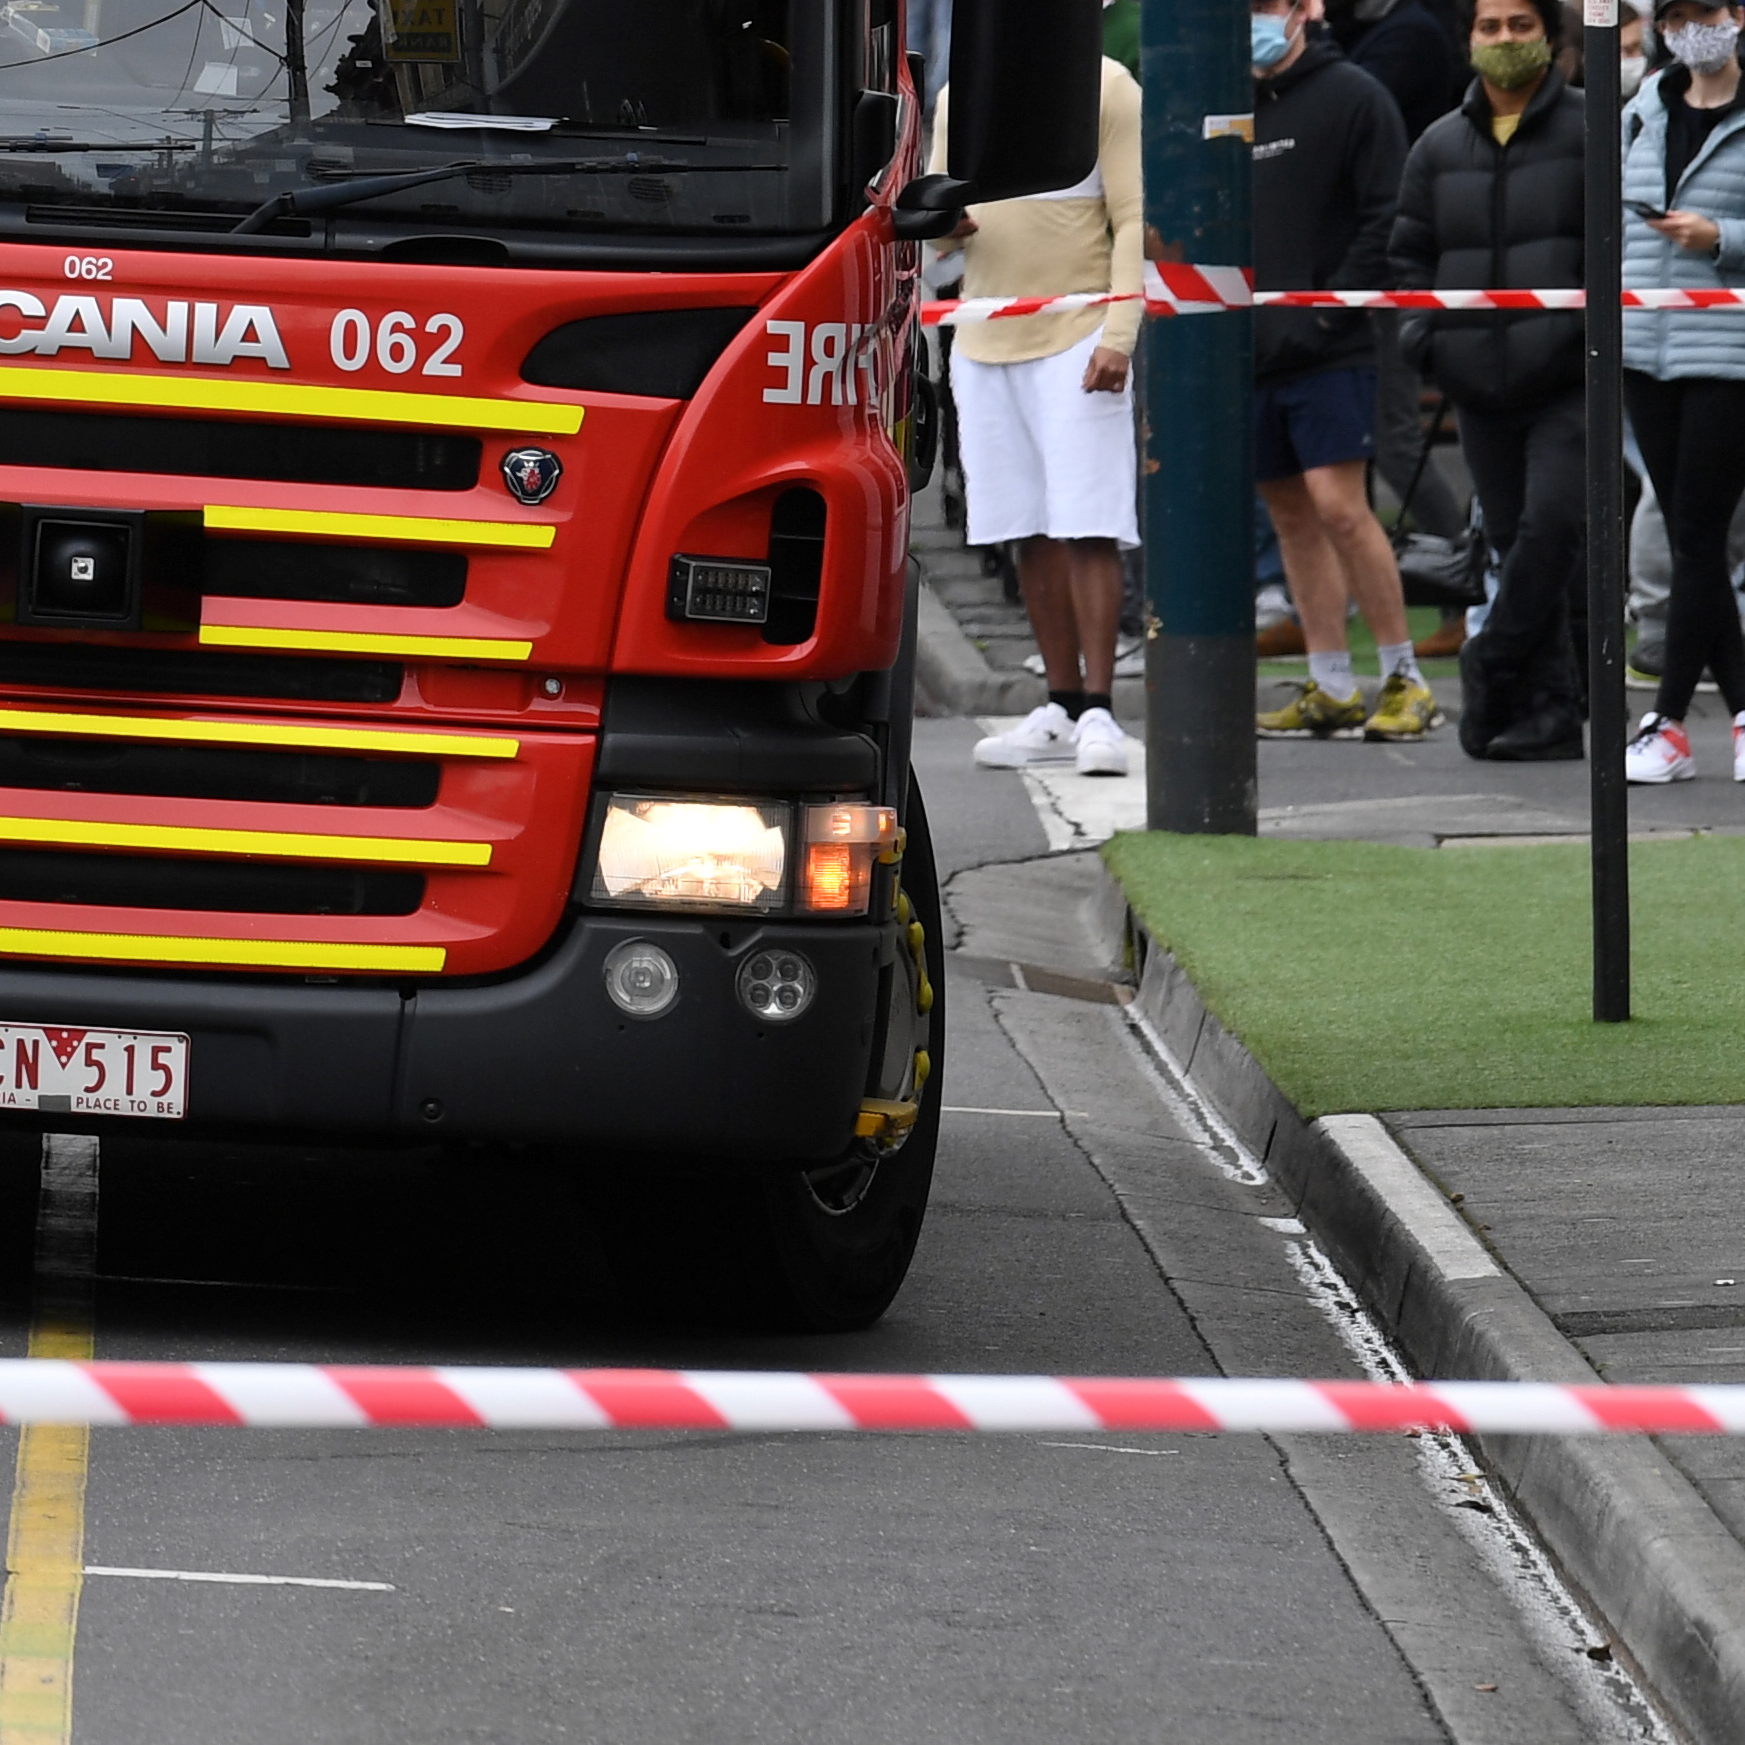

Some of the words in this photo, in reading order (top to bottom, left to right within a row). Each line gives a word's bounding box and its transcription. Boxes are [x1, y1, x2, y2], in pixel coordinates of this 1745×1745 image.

[63, 255, 113, 281] 062
[330, 308, 464, 377] 062
[83, 1042, 173, 1098] 515
[76, 1097, 120, 1111] PLACE
[129, 1099, 147, 1113] TO
[157, 1101, 175, 1115] BE
